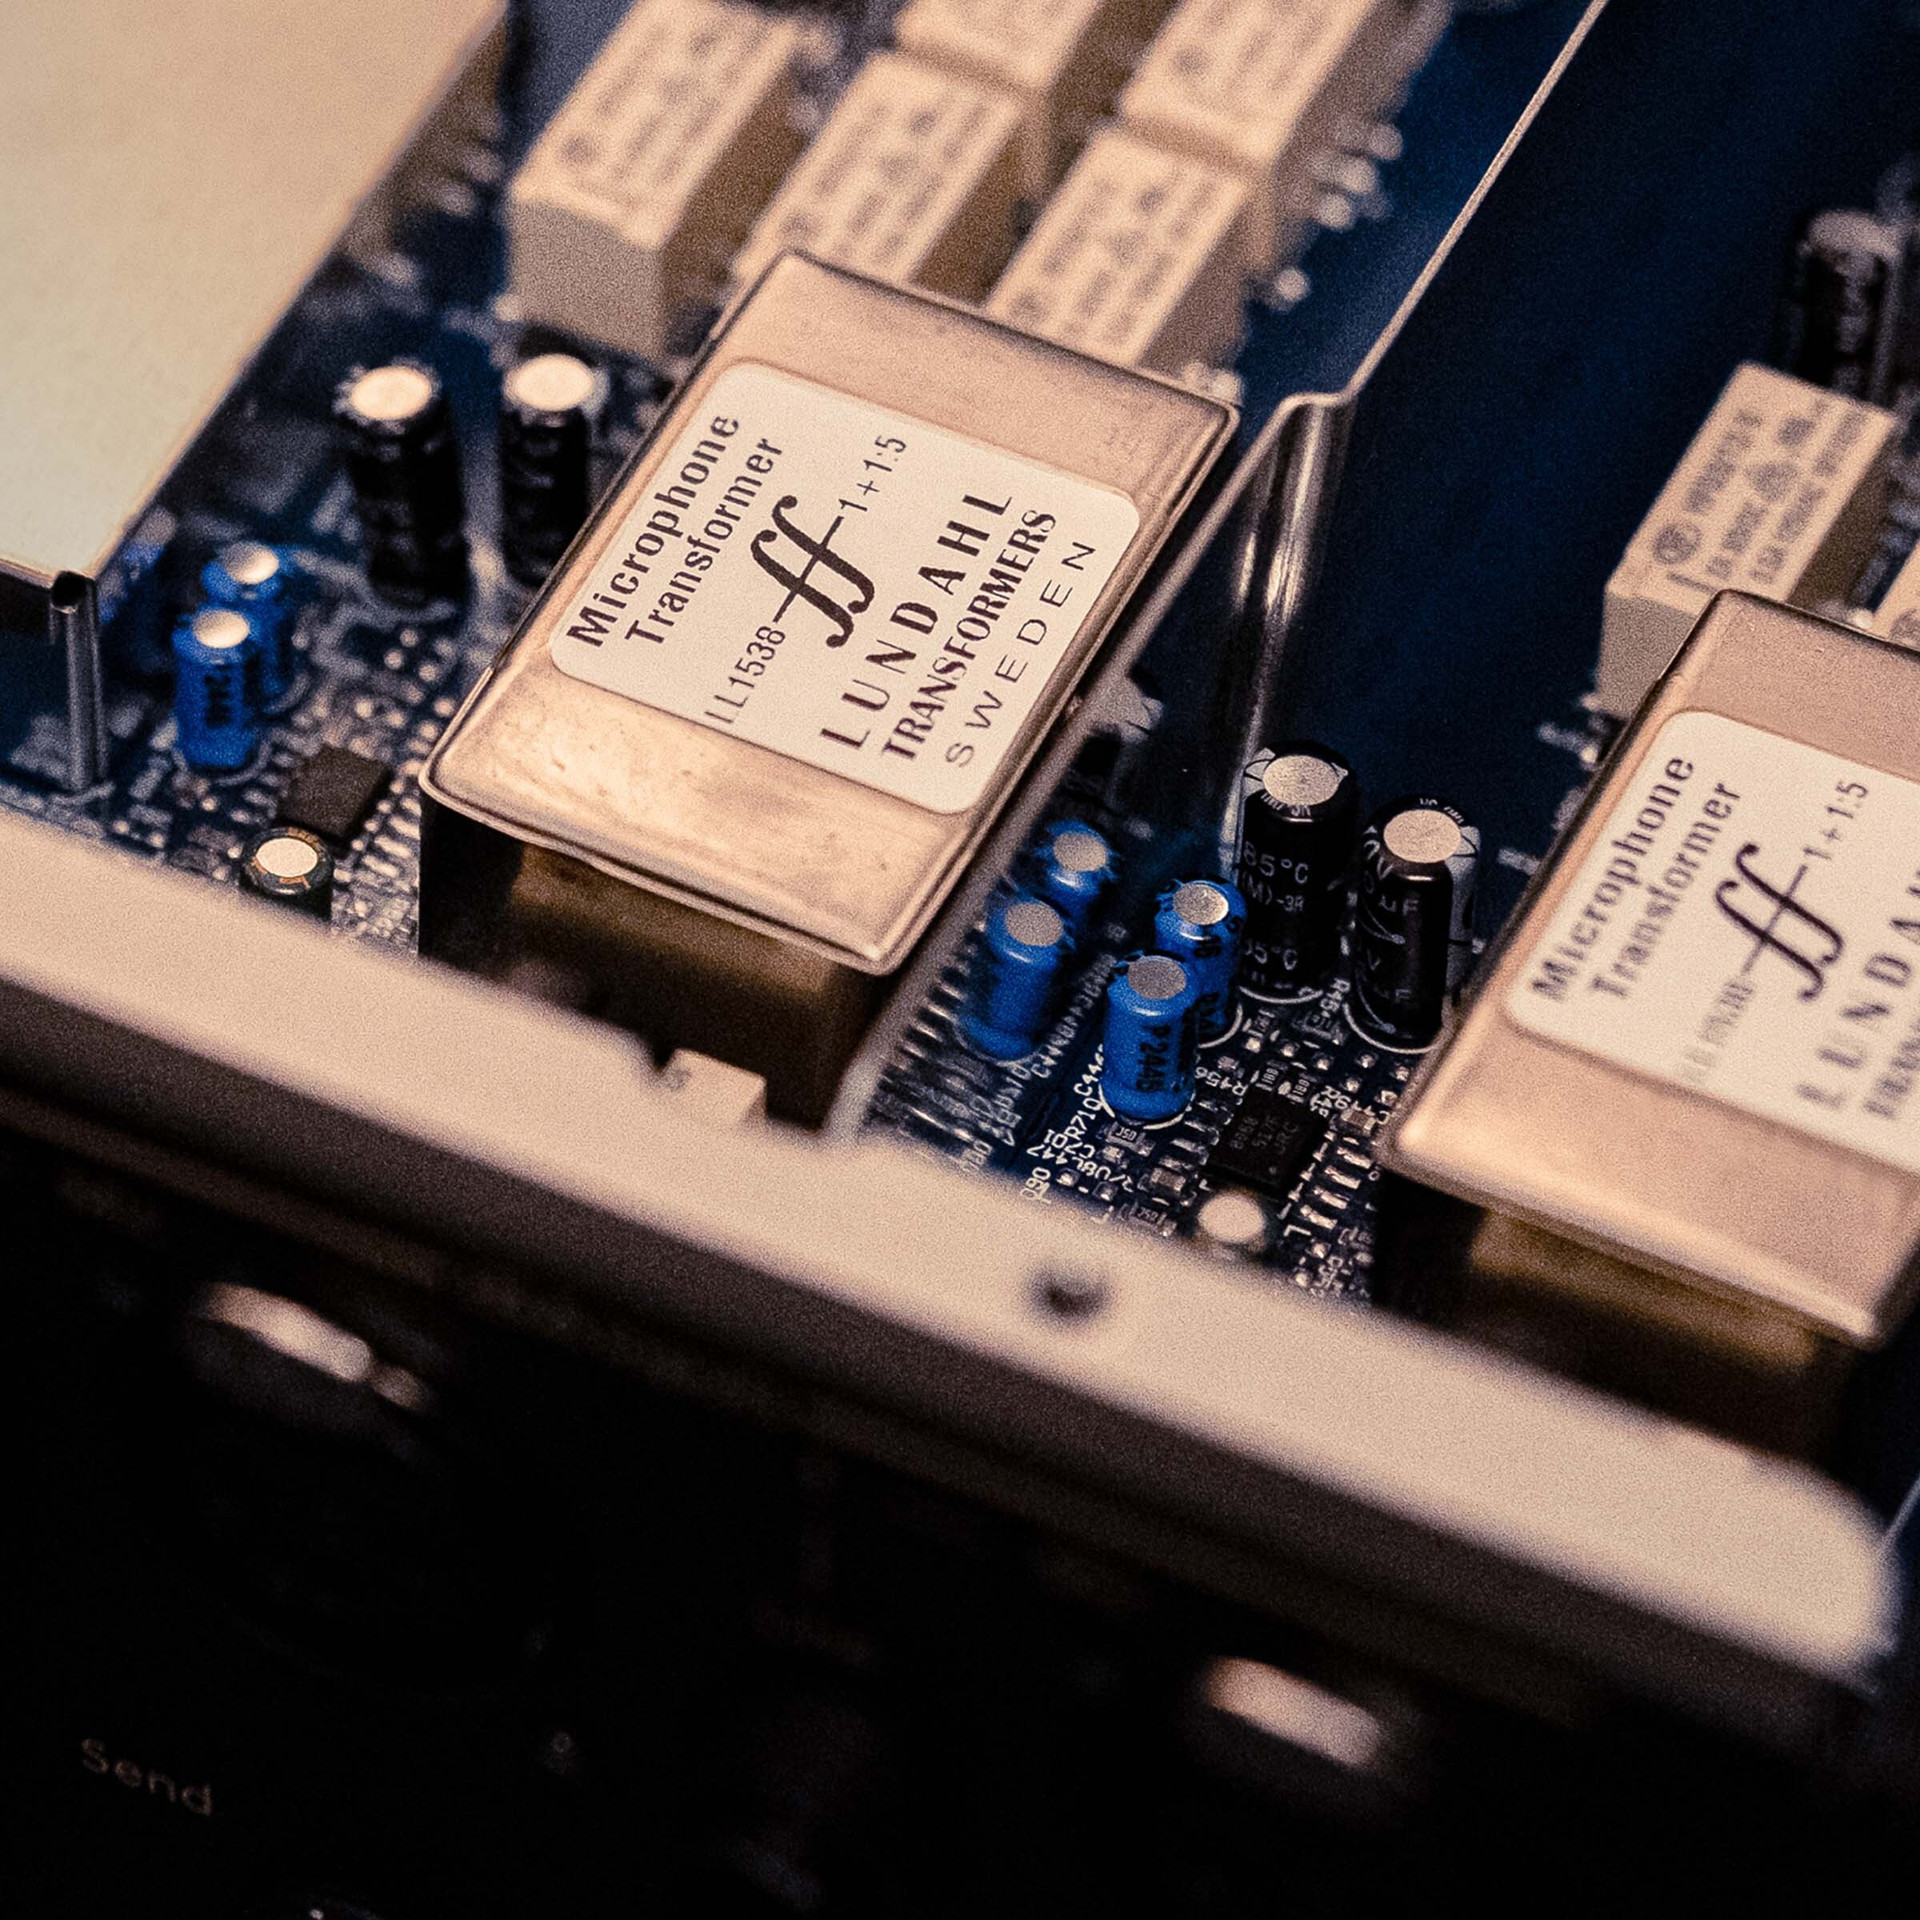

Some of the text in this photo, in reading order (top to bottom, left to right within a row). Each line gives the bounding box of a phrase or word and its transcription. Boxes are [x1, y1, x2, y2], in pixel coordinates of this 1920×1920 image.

[566, 415, 739, 649] Microphone
[624, 437, 784, 645] Transformer
[820, 493, 1013, 750] LUNDAHL
[881, 508, 1057, 760] TRANSFORMERS
[945, 541, 1096, 768] SWEDEN
[1531, 756, 1695, 1002] Microphone
[1591, 781, 1742, 1000] Transformer
[79, 1736, 215, 1819] Send
